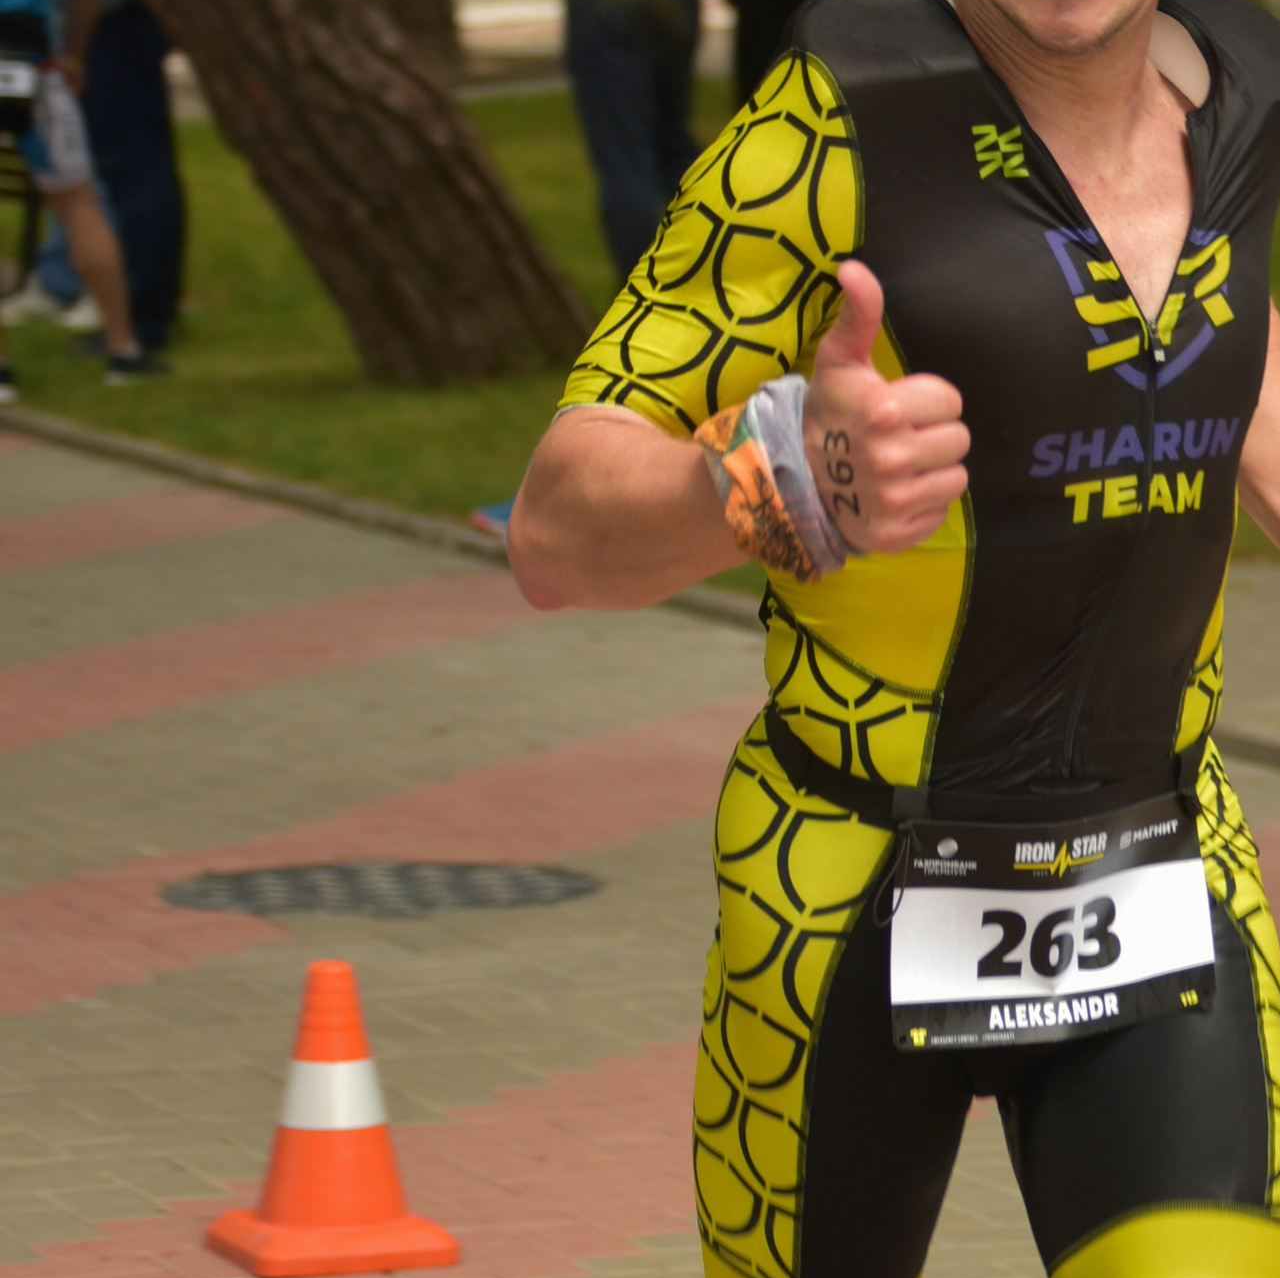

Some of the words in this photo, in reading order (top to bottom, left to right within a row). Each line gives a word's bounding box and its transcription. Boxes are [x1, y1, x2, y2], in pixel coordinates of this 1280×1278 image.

[823, 429, 861, 517] 263
[1029, 418, 1240, 478] SHARUN
[1064, 470, 1204, 524] TEAM
[1014, 841, 1056, 864] IRON
[1071, 832, 1108, 859] STAR
[976, 894, 1121, 980] 263
[989, 992, 1120, 1030] ALEKSANDR
